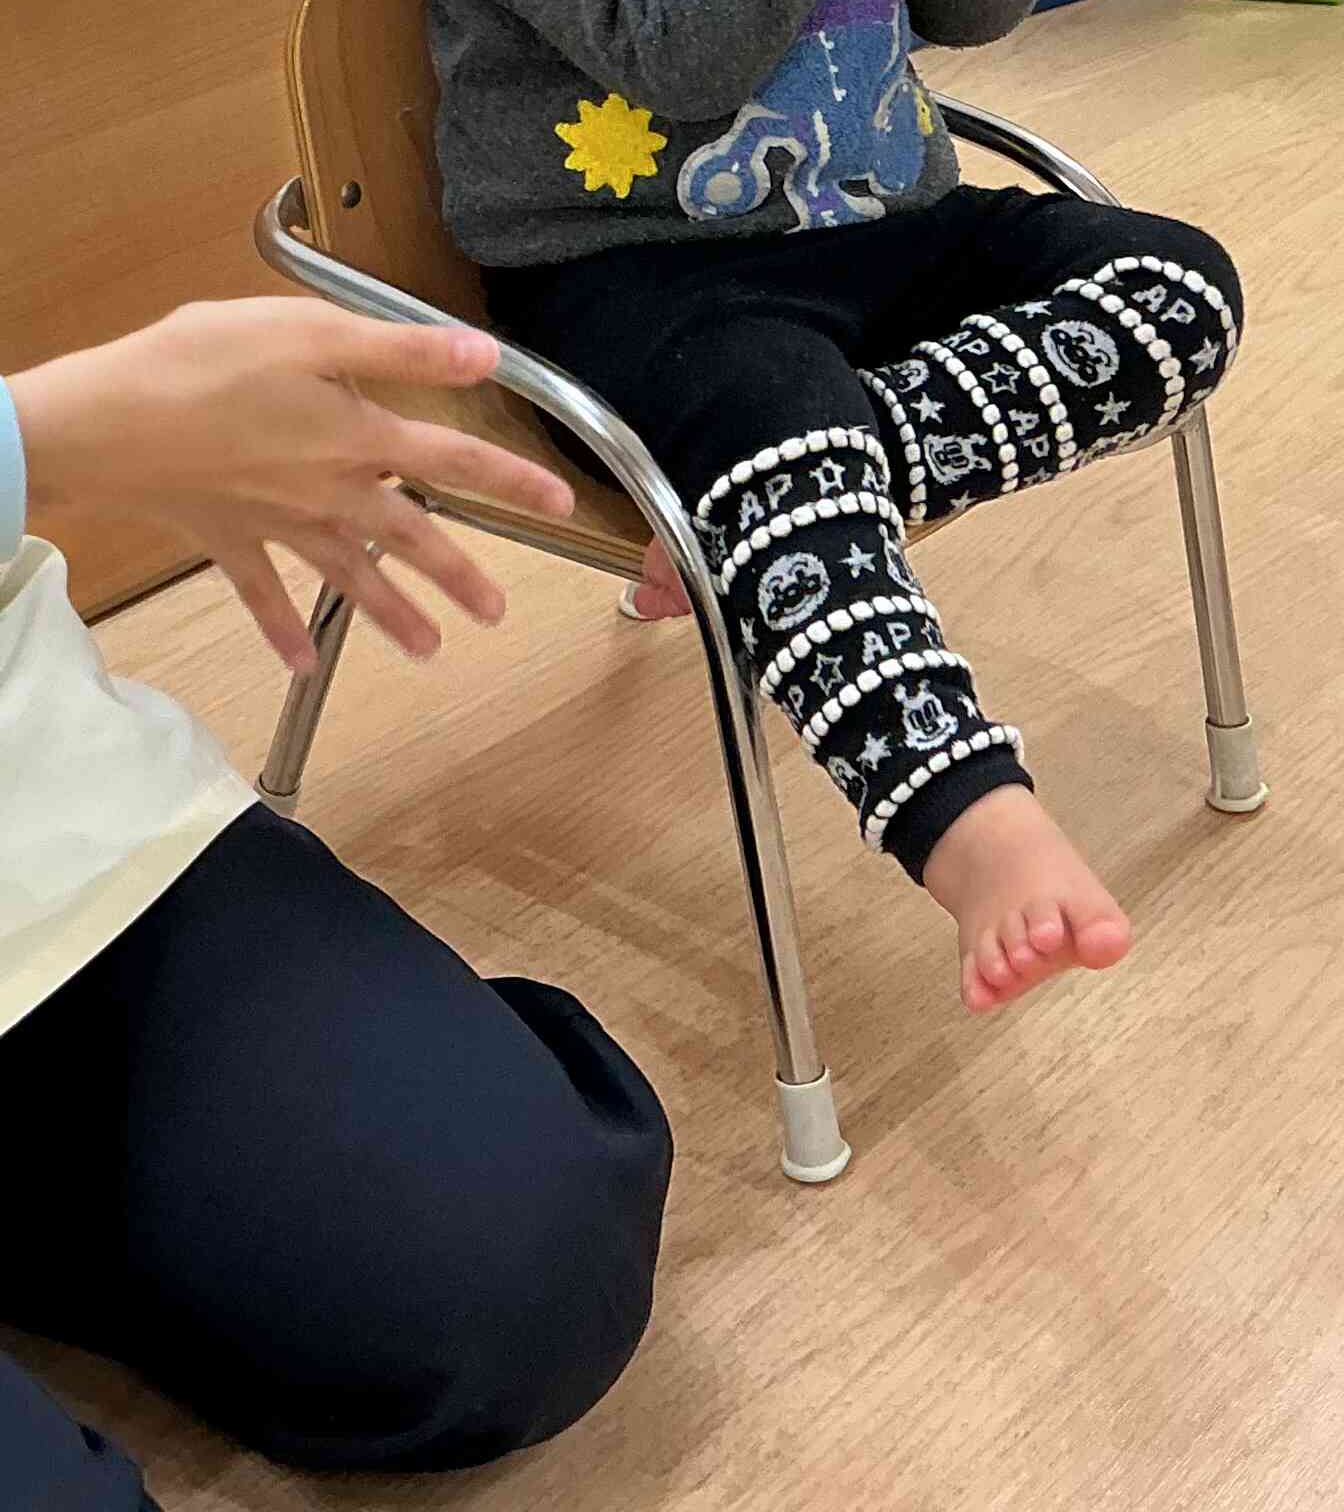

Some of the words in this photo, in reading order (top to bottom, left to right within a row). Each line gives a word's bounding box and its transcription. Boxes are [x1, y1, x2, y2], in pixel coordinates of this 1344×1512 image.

[1131, 284, 1197, 325] AP
[739, 474, 794, 533] AP
[862, 621, 912, 666] AP
